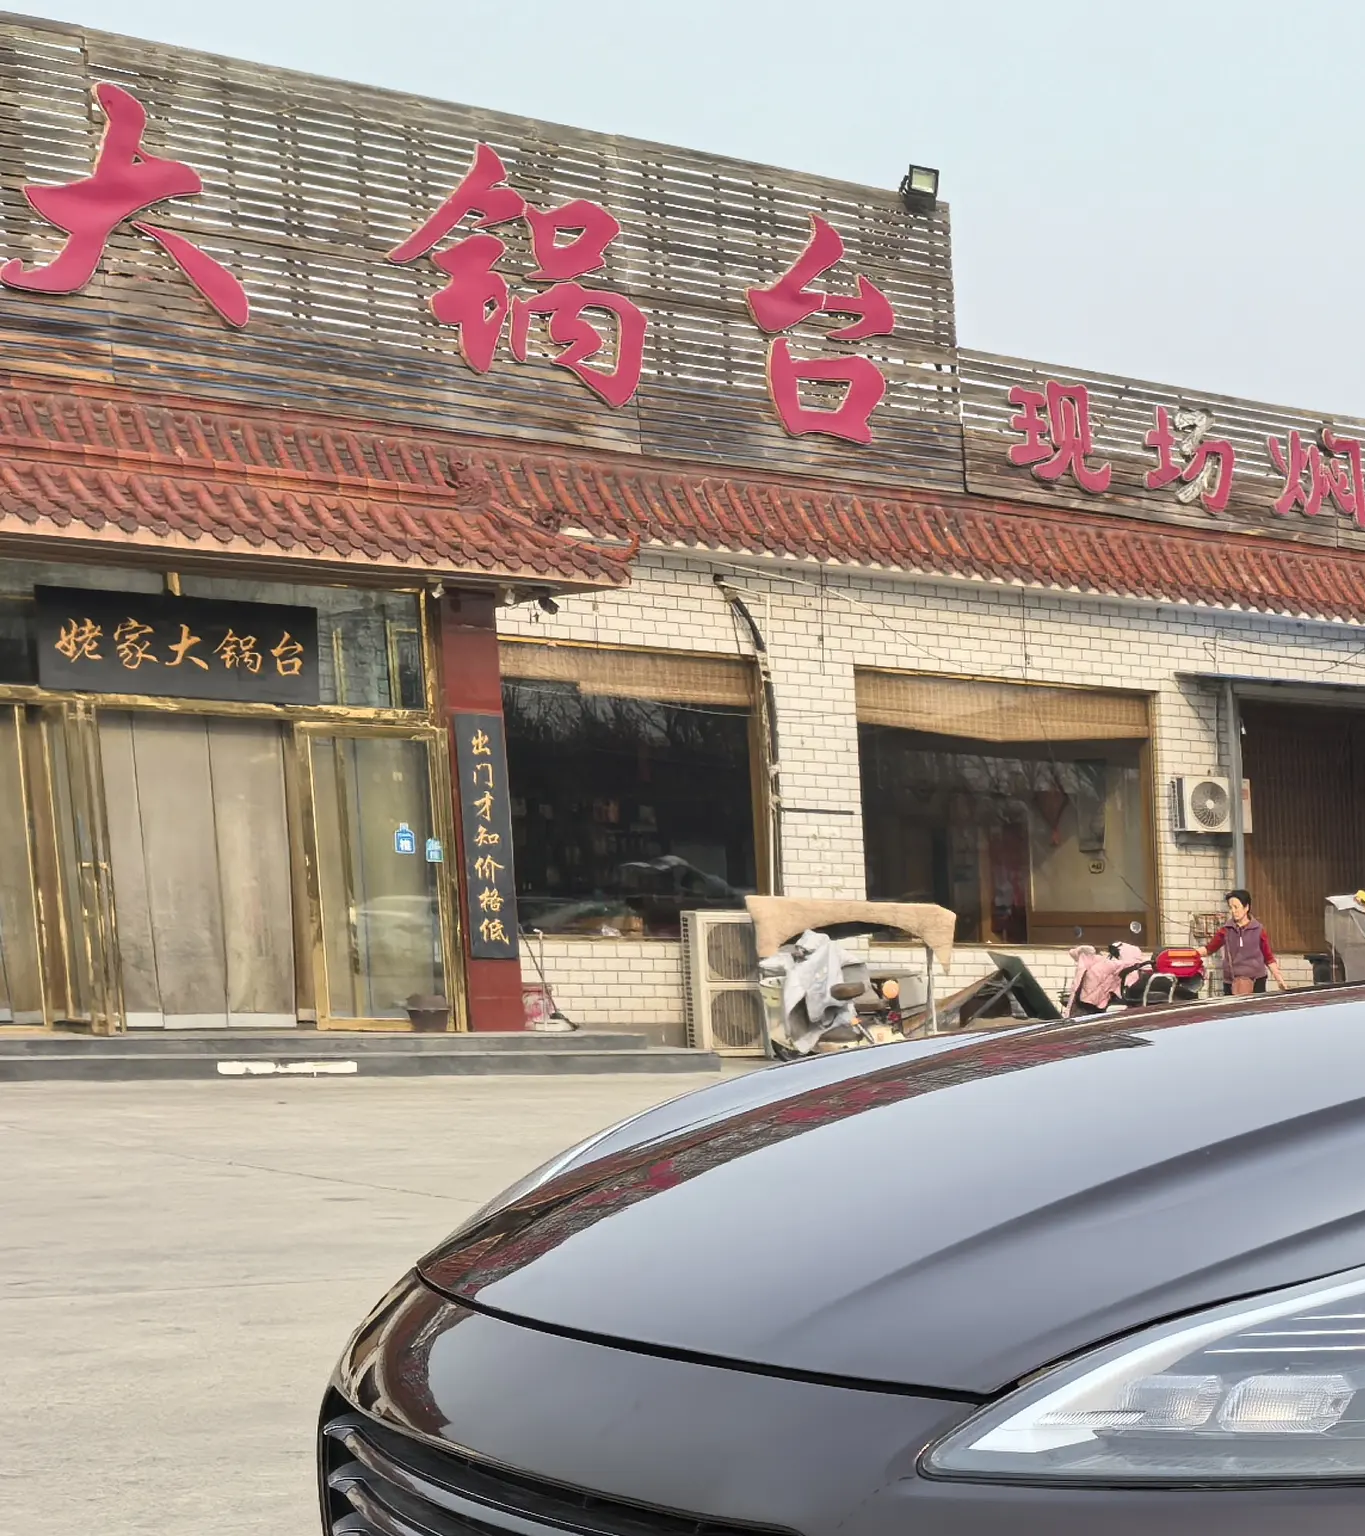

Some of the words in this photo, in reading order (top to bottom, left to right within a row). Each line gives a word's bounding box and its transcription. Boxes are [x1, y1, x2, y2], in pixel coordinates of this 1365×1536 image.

[0, 80, 896, 445] 大锅台
[54, 616, 305, 676] 姥家大锅台
[470, 729, 511, 945] 出门才知价格低
